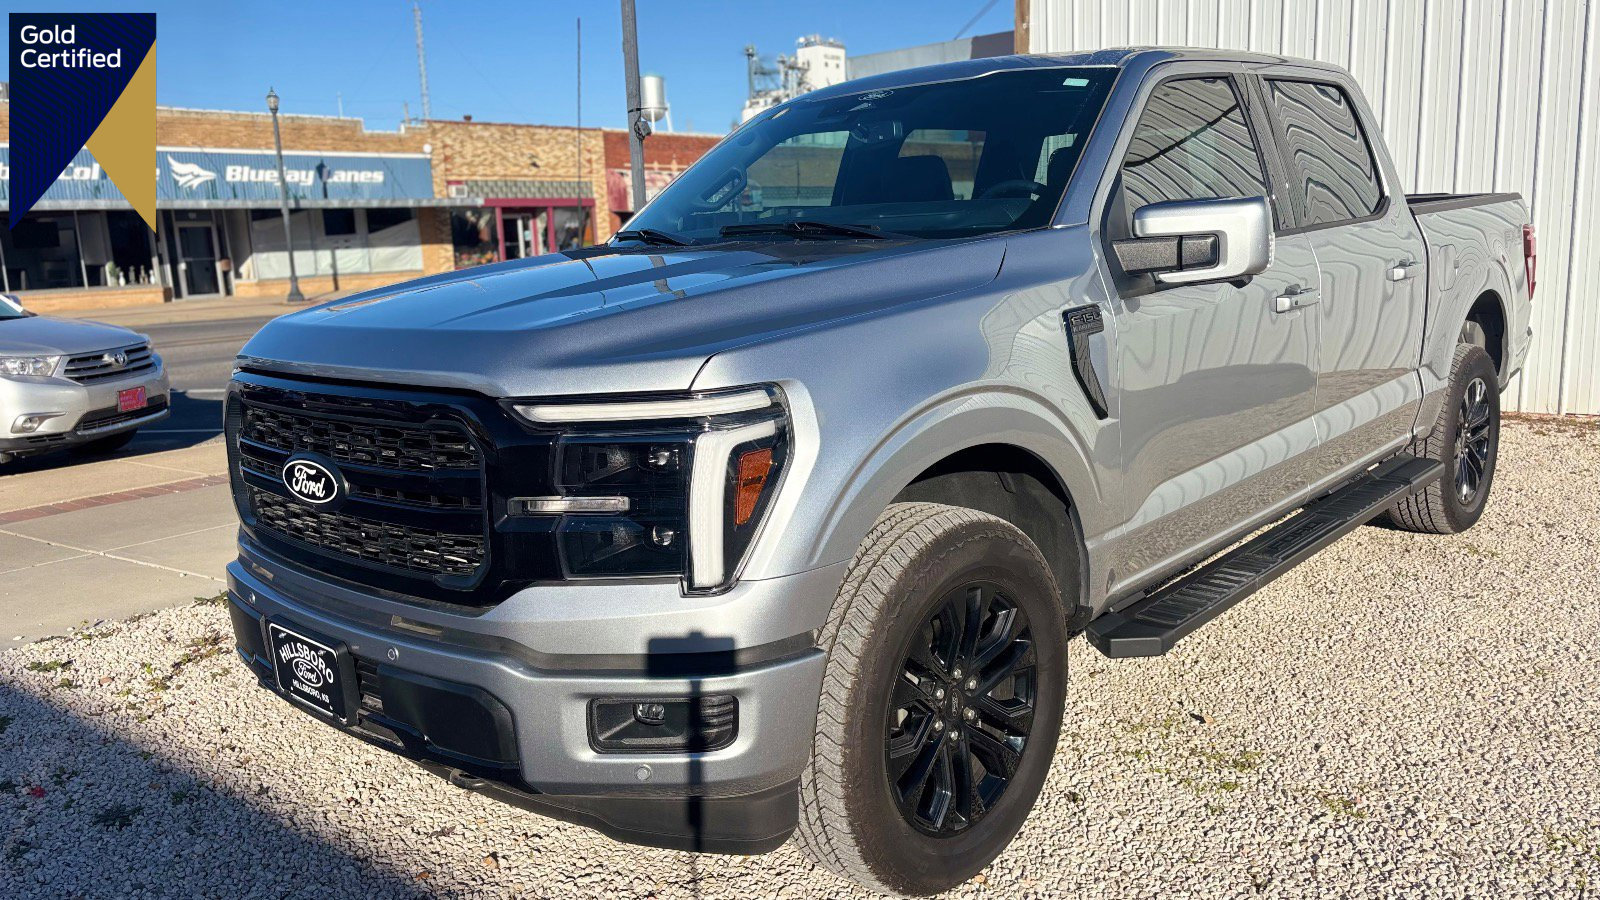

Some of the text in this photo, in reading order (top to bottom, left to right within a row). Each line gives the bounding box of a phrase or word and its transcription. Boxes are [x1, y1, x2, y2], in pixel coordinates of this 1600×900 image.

[322, 166, 385, 183] Lanes
[292, 464, 326, 498] Ford
[279, 641, 334, 684] HILLSBORO
[296, 661, 318, 683] Ford
